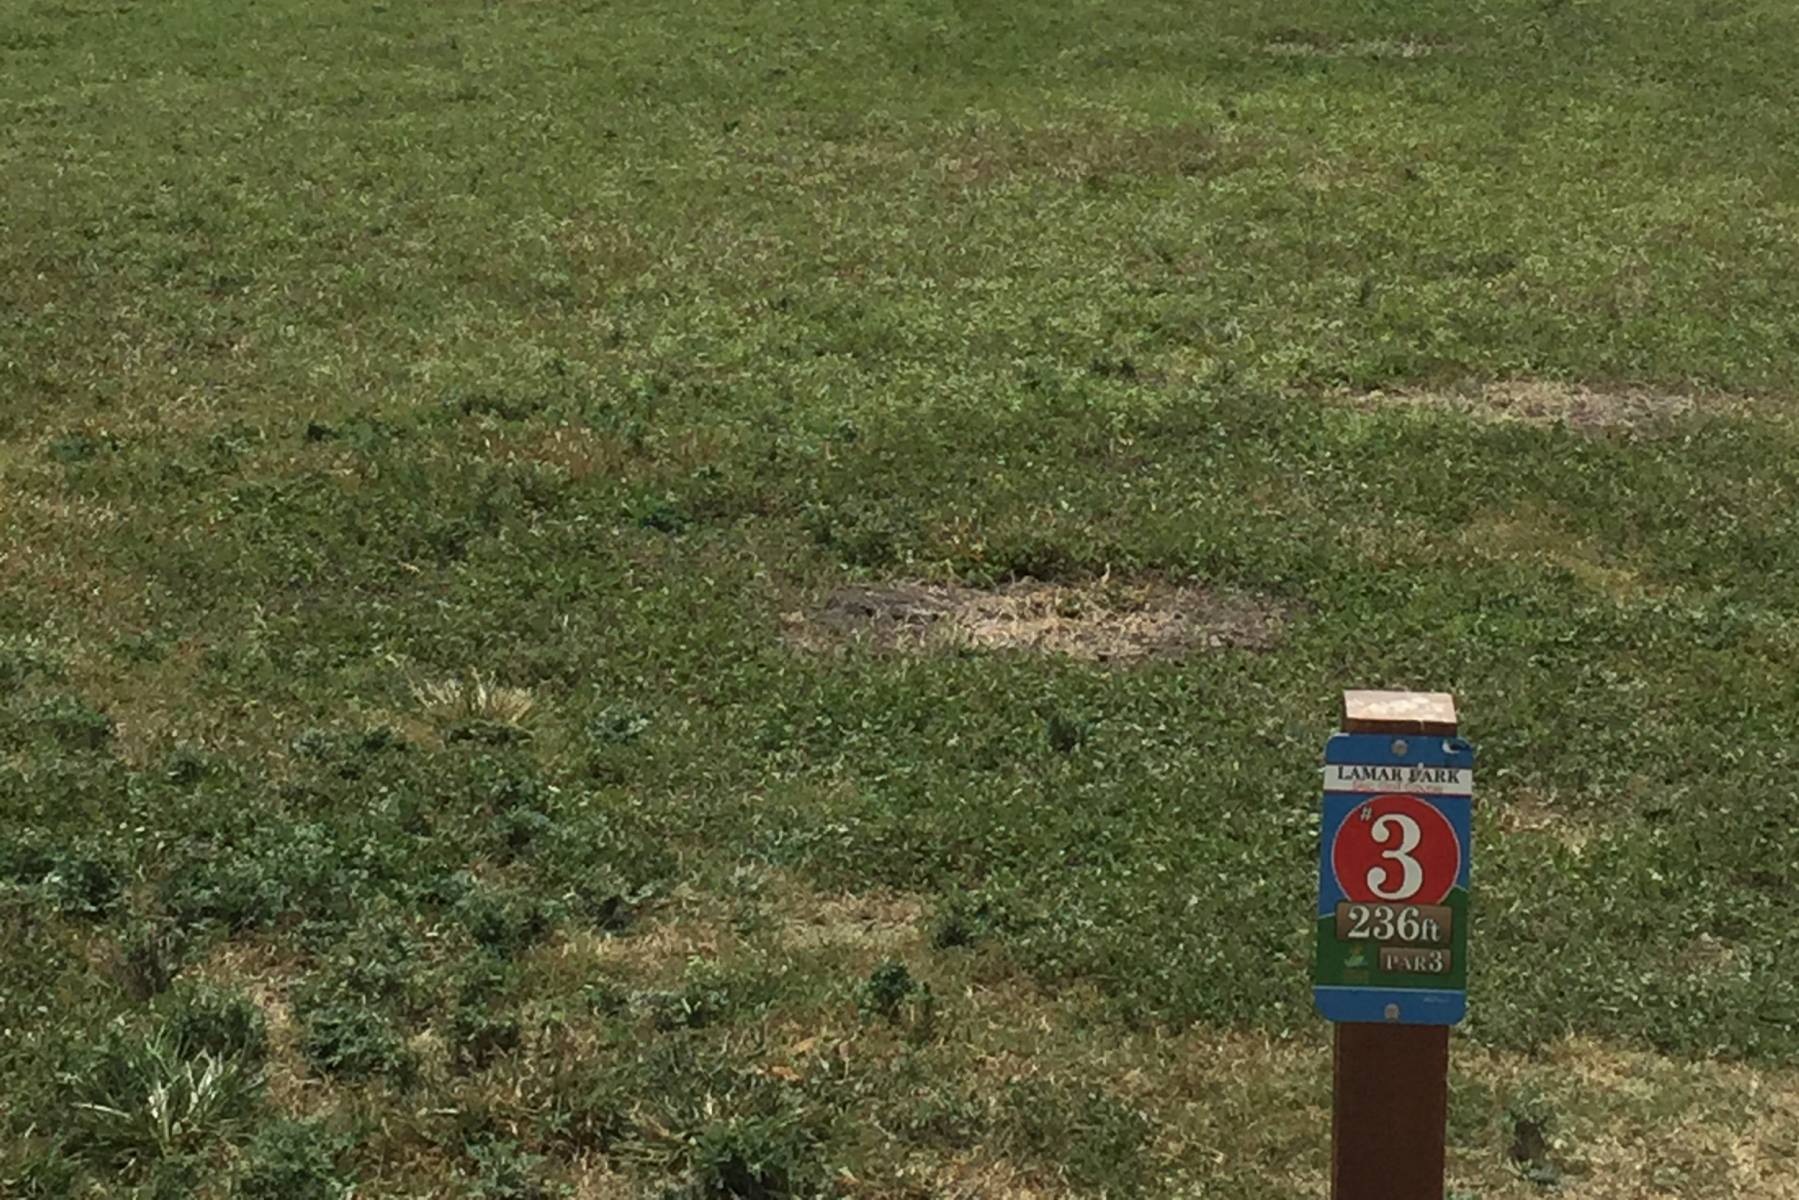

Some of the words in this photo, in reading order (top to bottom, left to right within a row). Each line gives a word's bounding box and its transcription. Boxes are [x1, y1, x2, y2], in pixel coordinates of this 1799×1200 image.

[1338, 766, 1402, 782] LAMAR
[1409, 768, 1460, 784] PARK
[1347, 905, 1441, 942] 236ft
